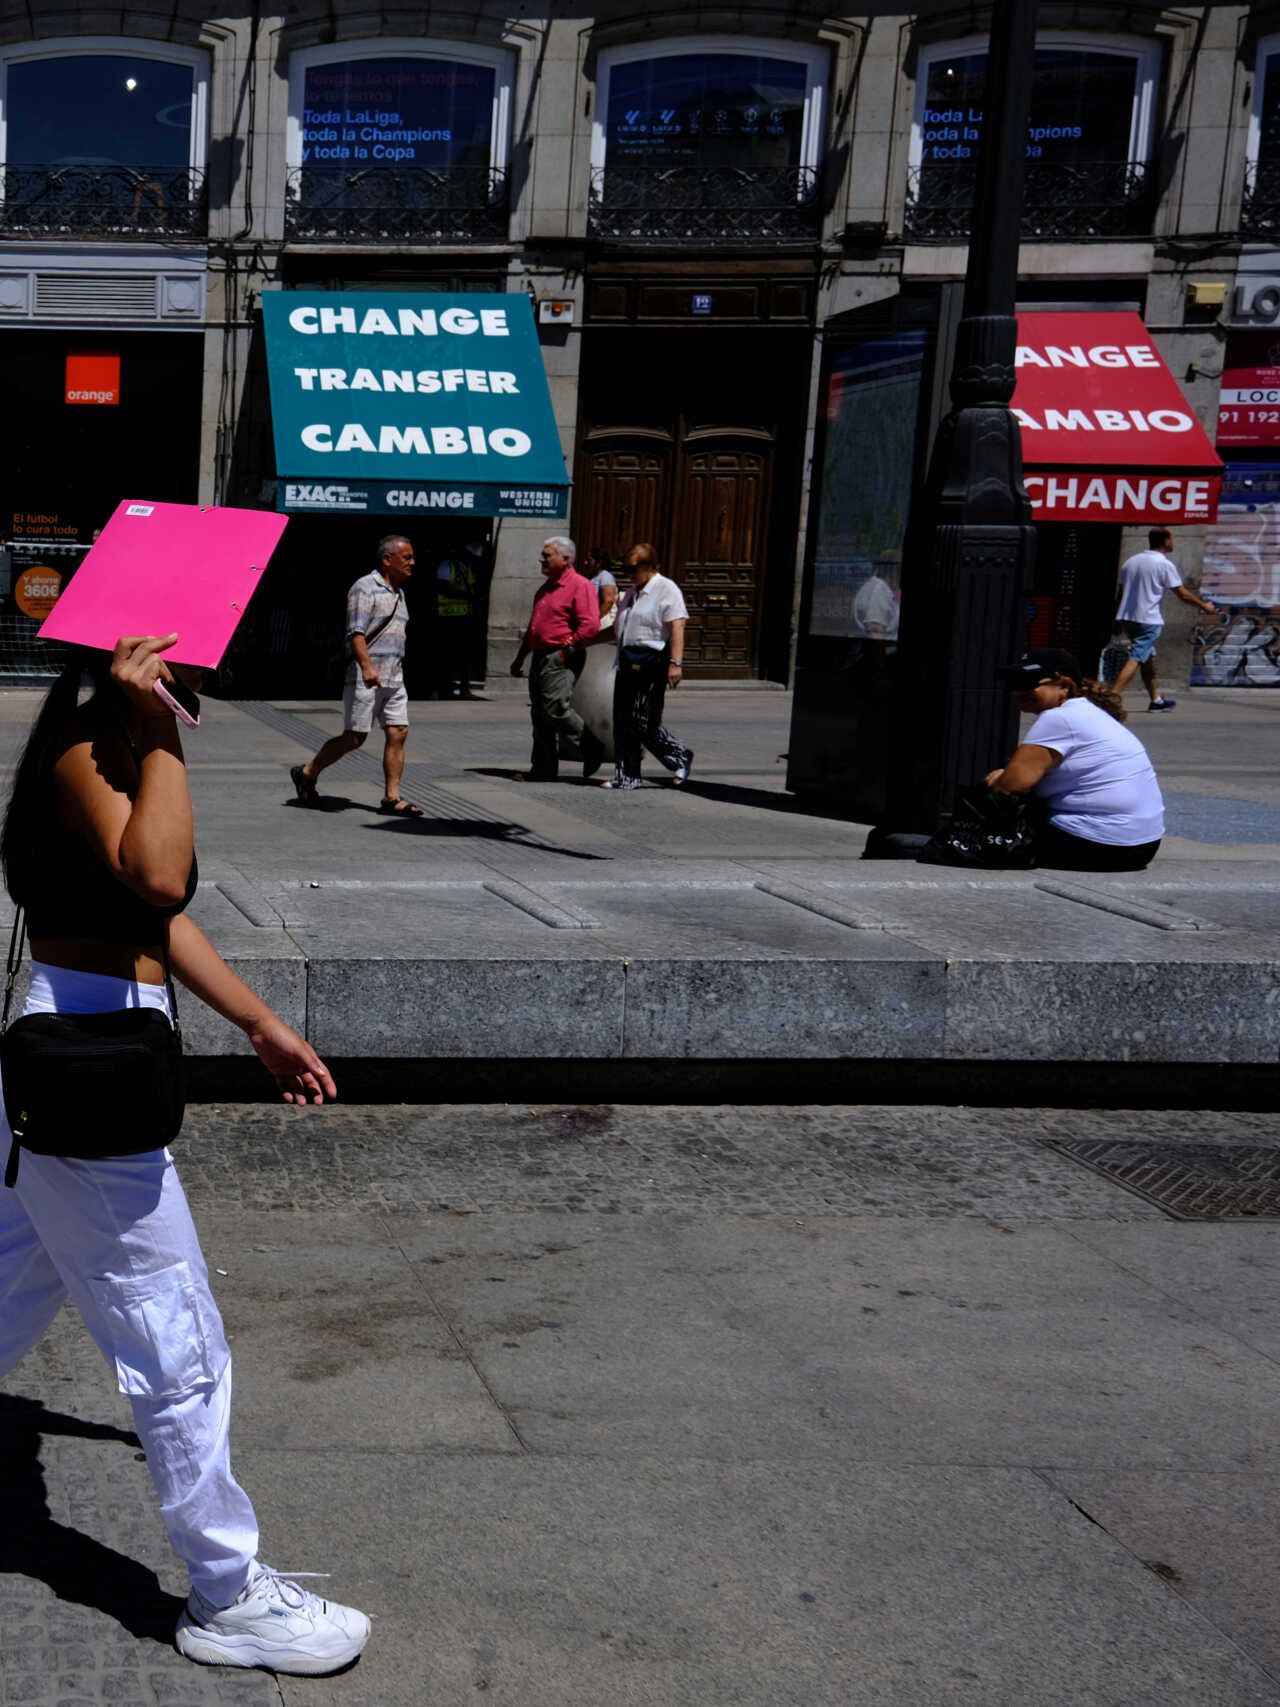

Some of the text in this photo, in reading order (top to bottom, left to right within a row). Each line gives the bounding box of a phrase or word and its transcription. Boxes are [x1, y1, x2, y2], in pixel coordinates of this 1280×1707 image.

[304, 109, 404, 126] Toda LaLiga,
[303, 128, 452, 144] toda la Champions
[925, 127, 959, 142] oda
[964, 127, 980, 142] la
[315, 145, 350, 159] toda
[354, 145, 368, 159] la
[372, 145, 416, 161] Copa
[932, 144, 972, 159] toda
[696, 297, 710, 309] 12
[288, 305, 510, 338] CHANGE
[1014, 345, 1161, 369] ANGE
[294, 367, 521, 395] TRANSFER
[67, 389, 113, 404] orange
[1010, 408, 1194, 433] AMBIO
[1219, 411, 1280, 424] 91 192
[300, 423, 532, 458] CAMBIO
[386, 490, 475, 508] CHANGE
[499, 490, 551, 499] WESTERN
[1023, 477, 1210, 512] CHANGE
[514, 498, 551, 507] UNION
[12, 513, 25, 524] El
[13, 524, 79, 535] lo cura todo
[24, 584, 59, 597] 360€
